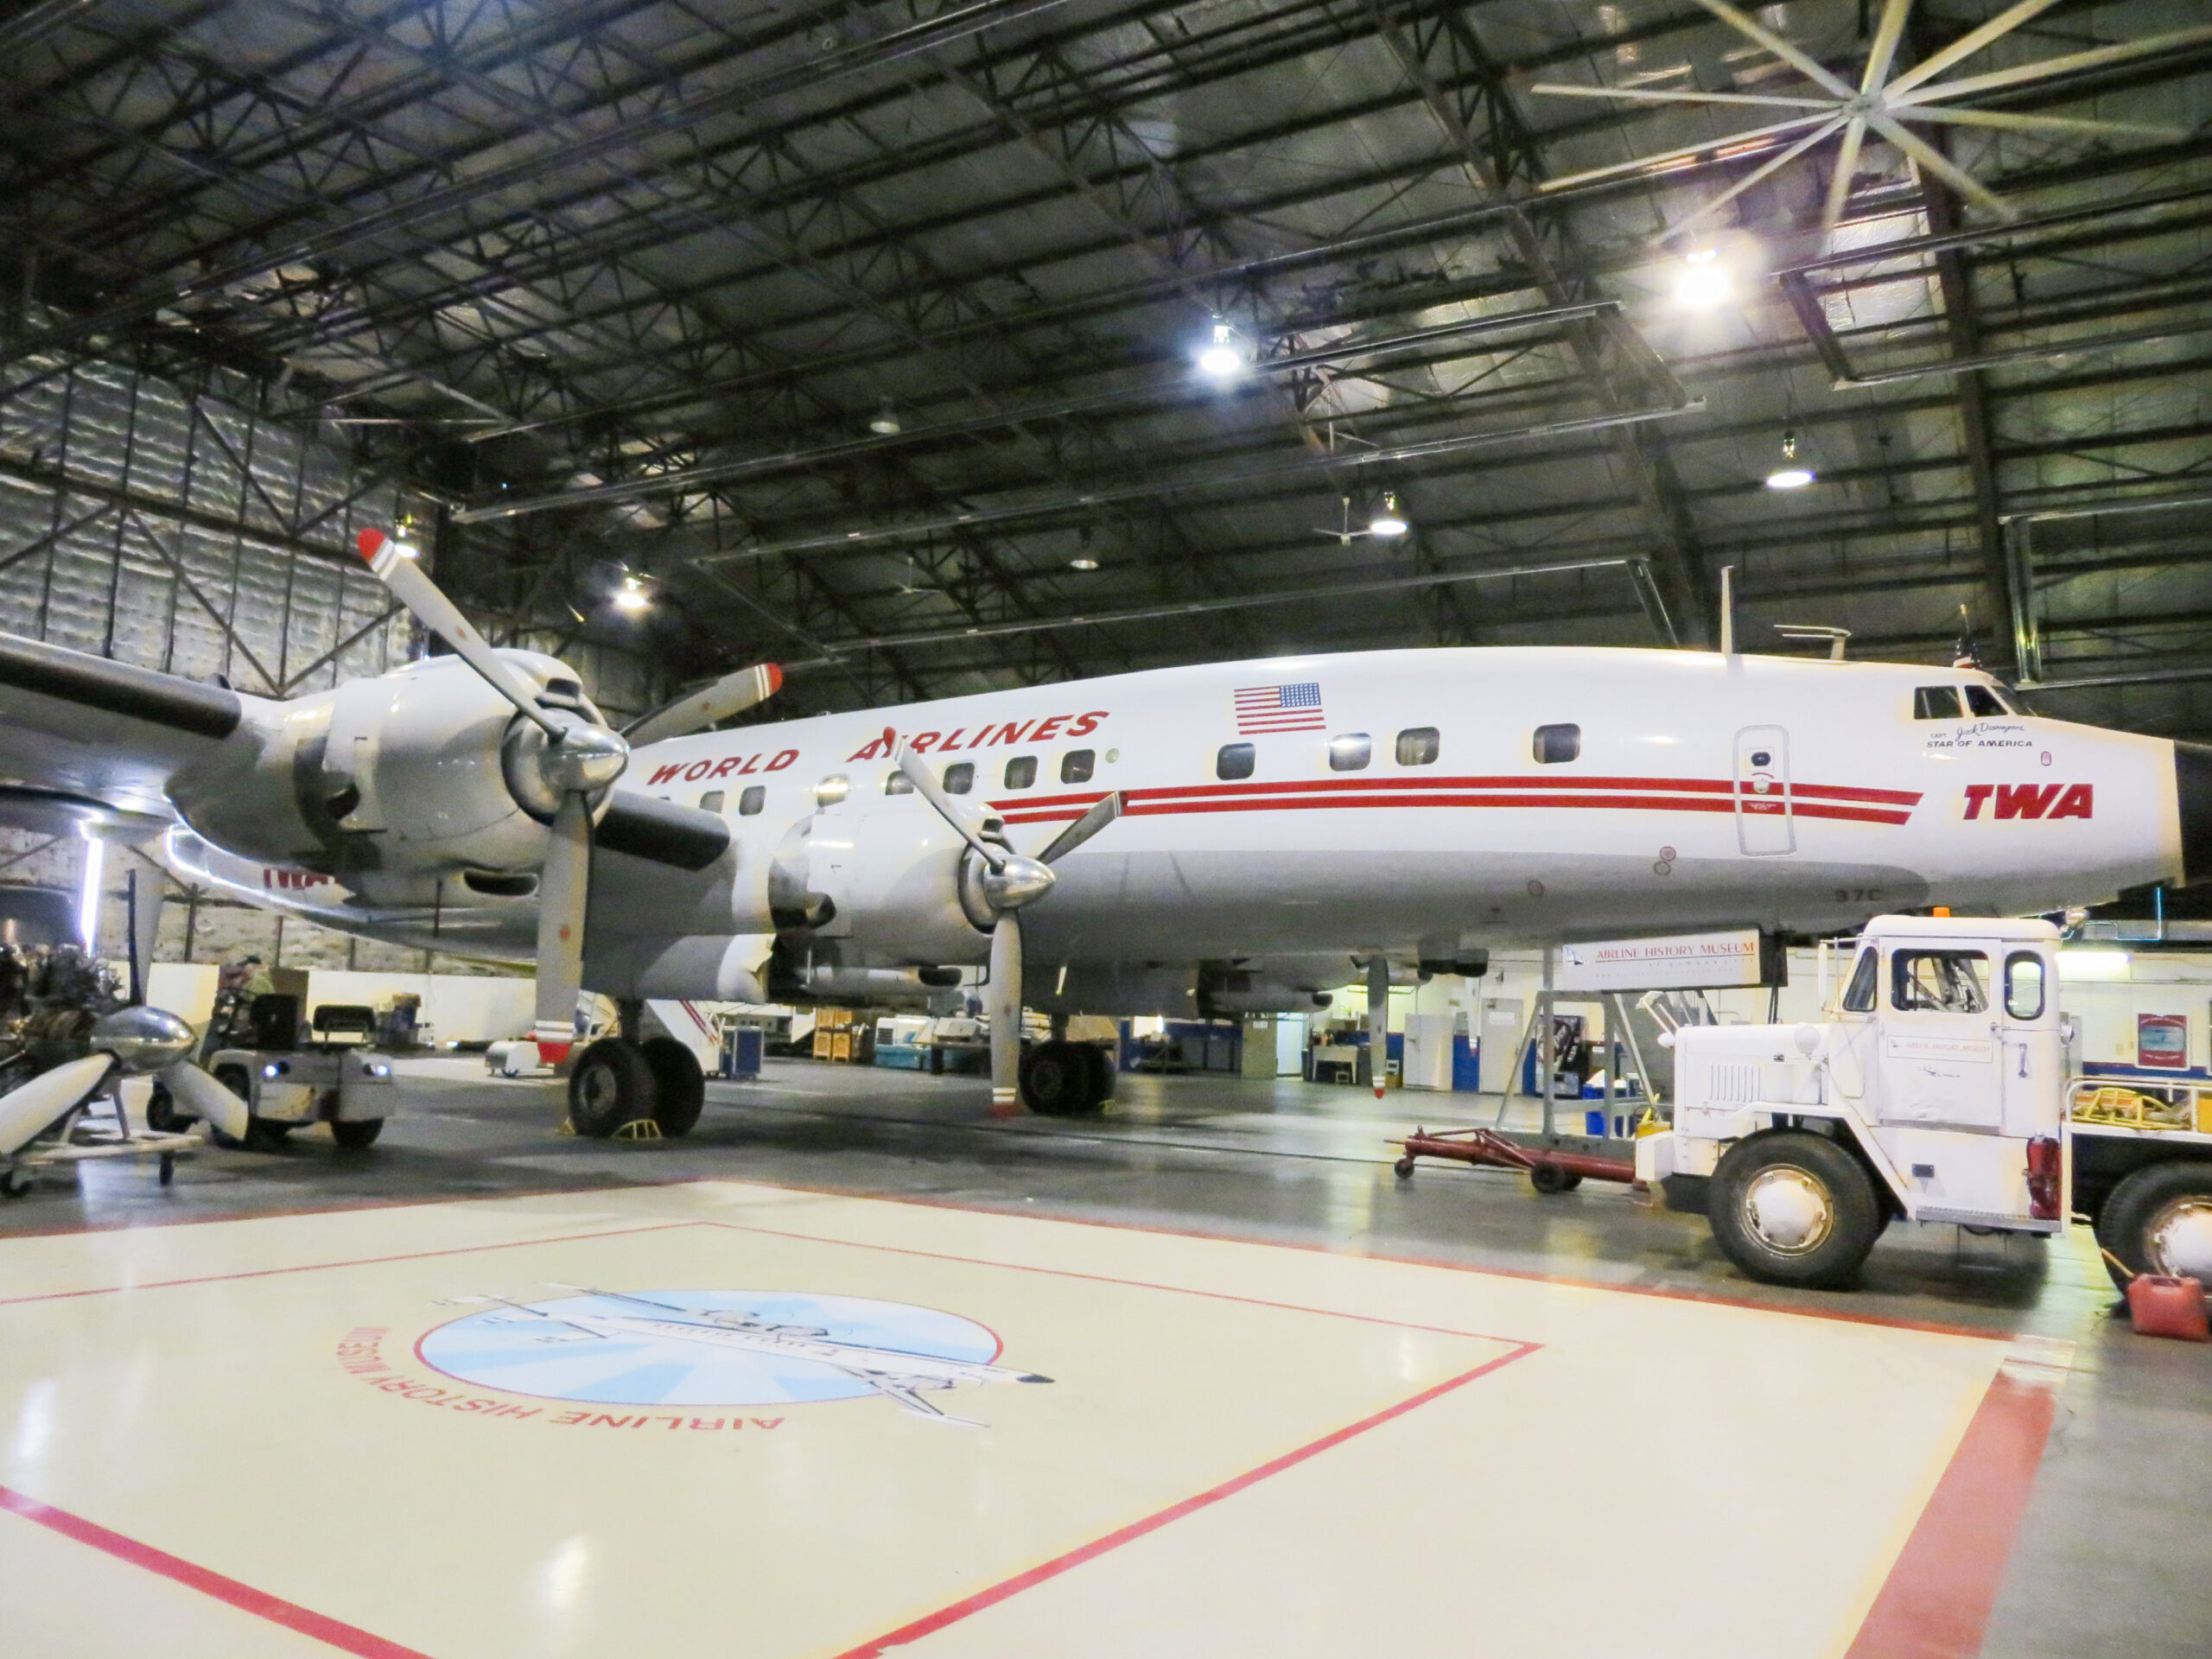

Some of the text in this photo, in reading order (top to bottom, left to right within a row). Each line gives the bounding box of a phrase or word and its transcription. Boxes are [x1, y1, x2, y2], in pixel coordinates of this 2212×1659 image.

[646, 748, 800, 785] WORLD
[1962, 783, 2094, 819] TWA
[1597, 942, 1755, 960] AIRLINE HISTORY MUSEUM
[359, 1375, 544, 1419] HISTORY
[548, 1410, 785, 1430] AIRLINE
